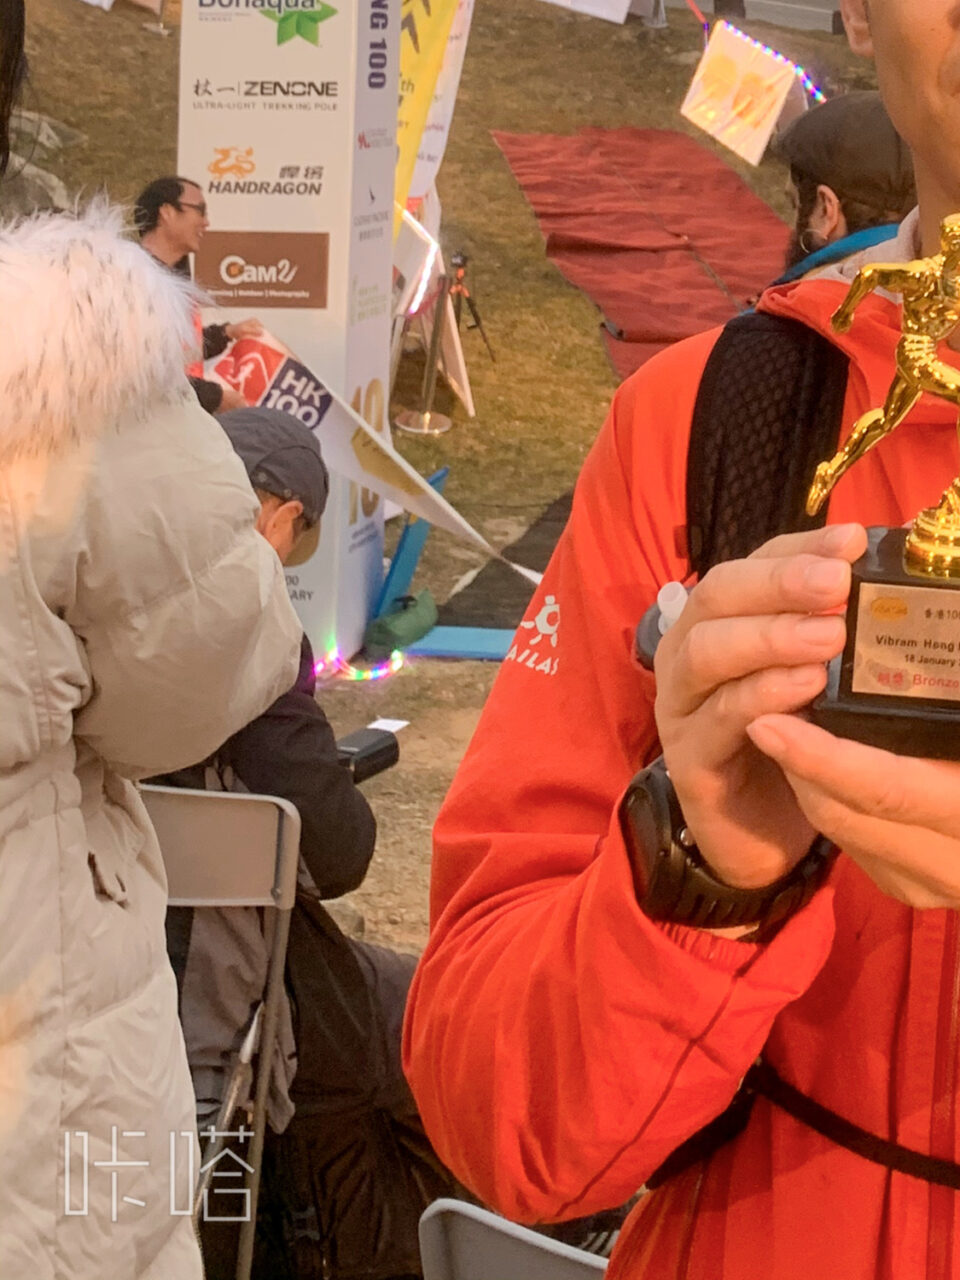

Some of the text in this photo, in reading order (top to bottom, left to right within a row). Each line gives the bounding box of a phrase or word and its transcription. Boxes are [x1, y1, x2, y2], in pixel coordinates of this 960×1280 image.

[367, 38, 388, 90] 100
[244, 80, 339, 98] ZENONE
[192, 101, 257, 111] ULTRA-LIGHT
[314, 102, 338, 112] POLE
[208, 180, 323, 196] HANDRAGON
[280, 368, 326, 408] HK
[266, 388, 320, 428] 100
[875, 634, 918, 649] Vibram
[923, 637, 955, 652] Hong
[505, 644, 559, 676] AILAS
[904, 653, 916, 664] 18
[917, 655, 956, 668] January
[912, 673, 960, 690] Bronze
